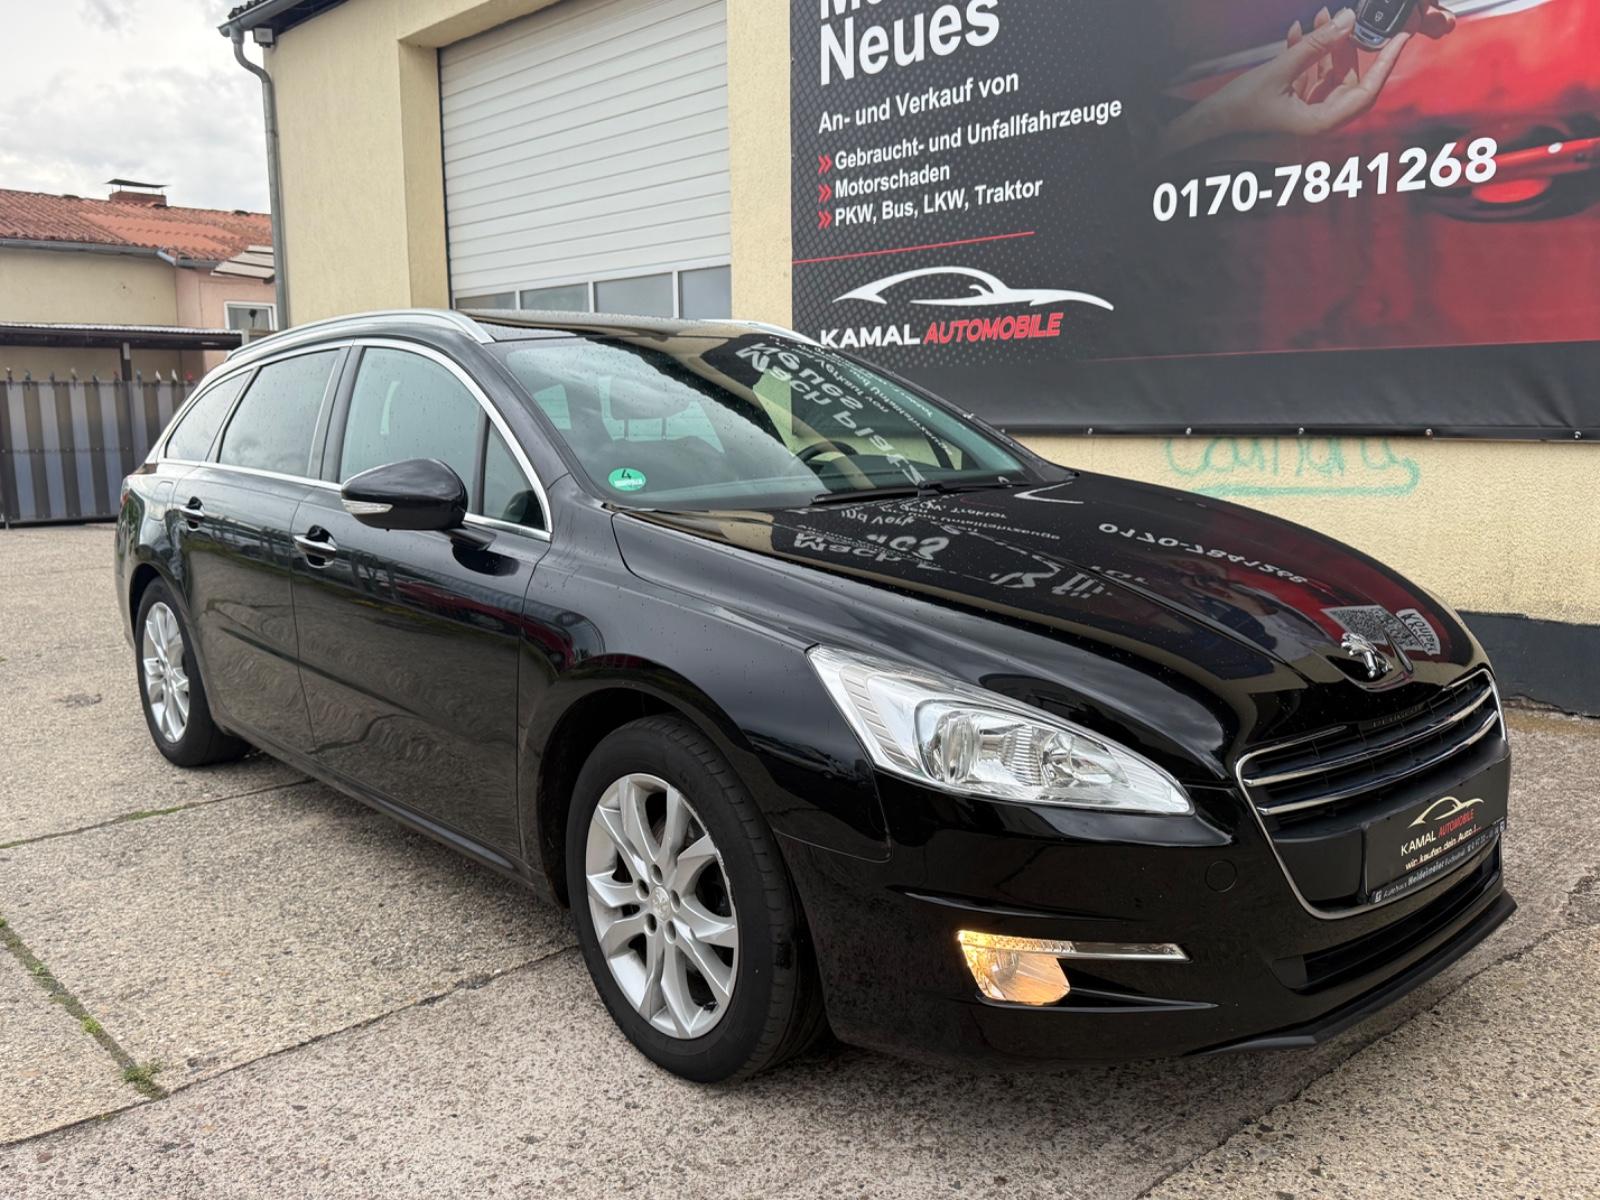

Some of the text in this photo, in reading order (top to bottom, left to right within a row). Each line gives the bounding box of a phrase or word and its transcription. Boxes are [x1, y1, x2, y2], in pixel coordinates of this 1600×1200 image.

[820, 0, 1000, 86] Neues
[818, 72, 1019, 134] An- und Verkauf von
[834, 100, 1123, 170] Gebraucht- und Unfallfahrzeuge
[835, 164, 950, 198] Motorschaden
[835, 179, 1043, 227] PKW, Bus, LKW, Traktor
[1152, 136, 1498, 222] 0170-7841268
[820, 312, 1065, 349] KAMAL AUTOMOBILE
[1400, 830, 1437, 857] KAMAL
[1439, 808, 1475, 838] AUTOMOBILE
